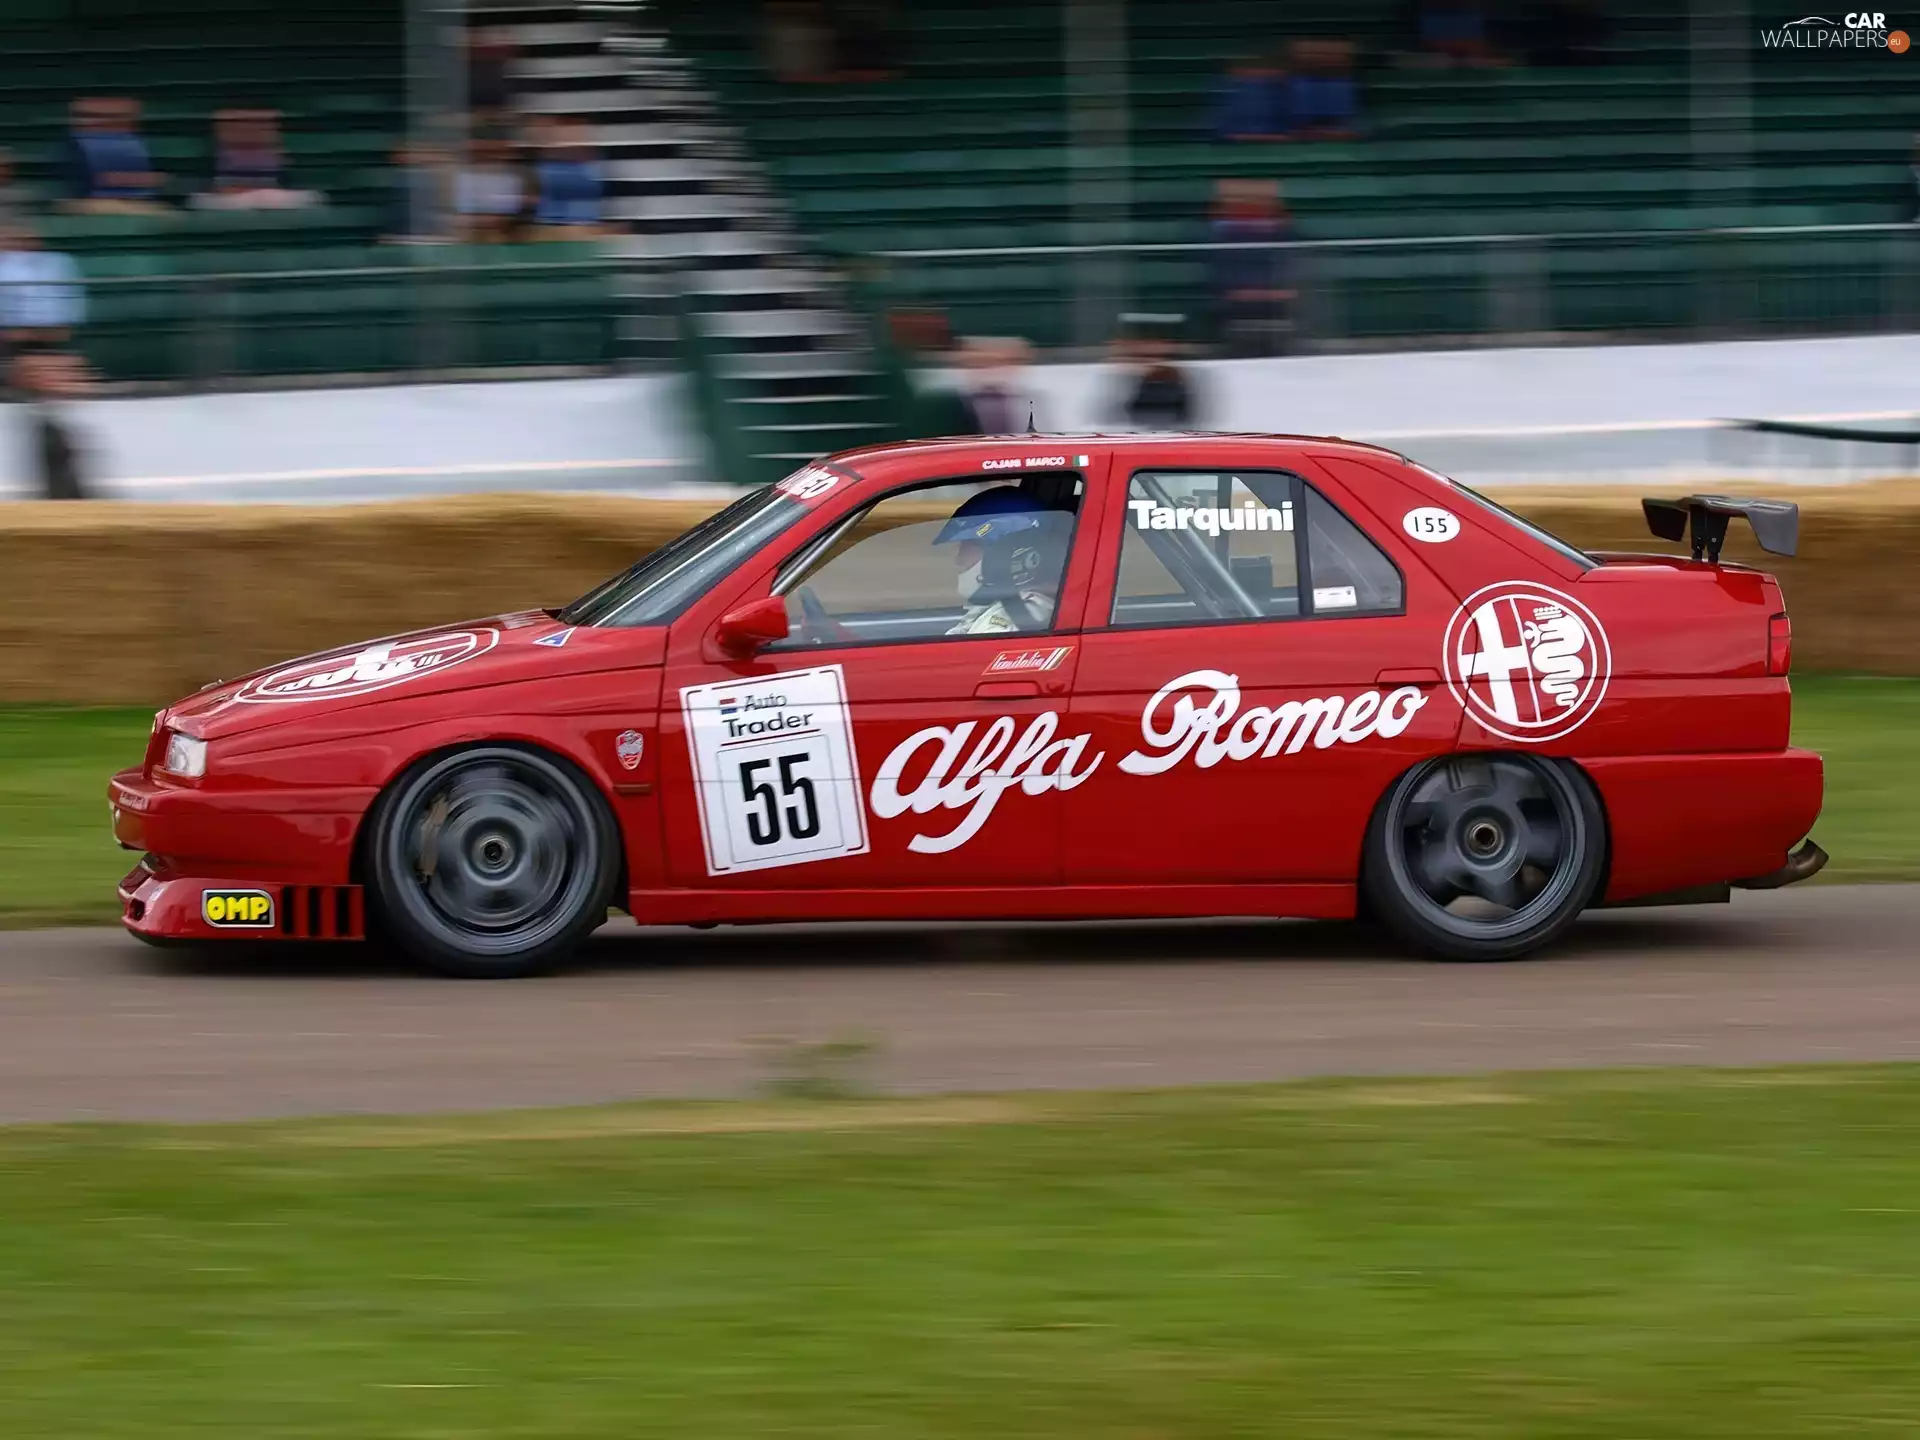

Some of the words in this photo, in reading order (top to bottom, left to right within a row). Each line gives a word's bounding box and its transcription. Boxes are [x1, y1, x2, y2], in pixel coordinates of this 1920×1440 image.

[1025, 456, 1065, 467] MARCO
[1128, 500, 1294, 536] Tarquini
[1414, 516, 1448, 533] 155
[744, 693, 788, 712] Auto
[722, 712, 814, 738] Trader
[871, 712, 1105, 853] Alfa
[1117, 670, 1429, 775] Romeo
[739, 752, 820, 846] 55
[207, 896, 270, 921] OMP
